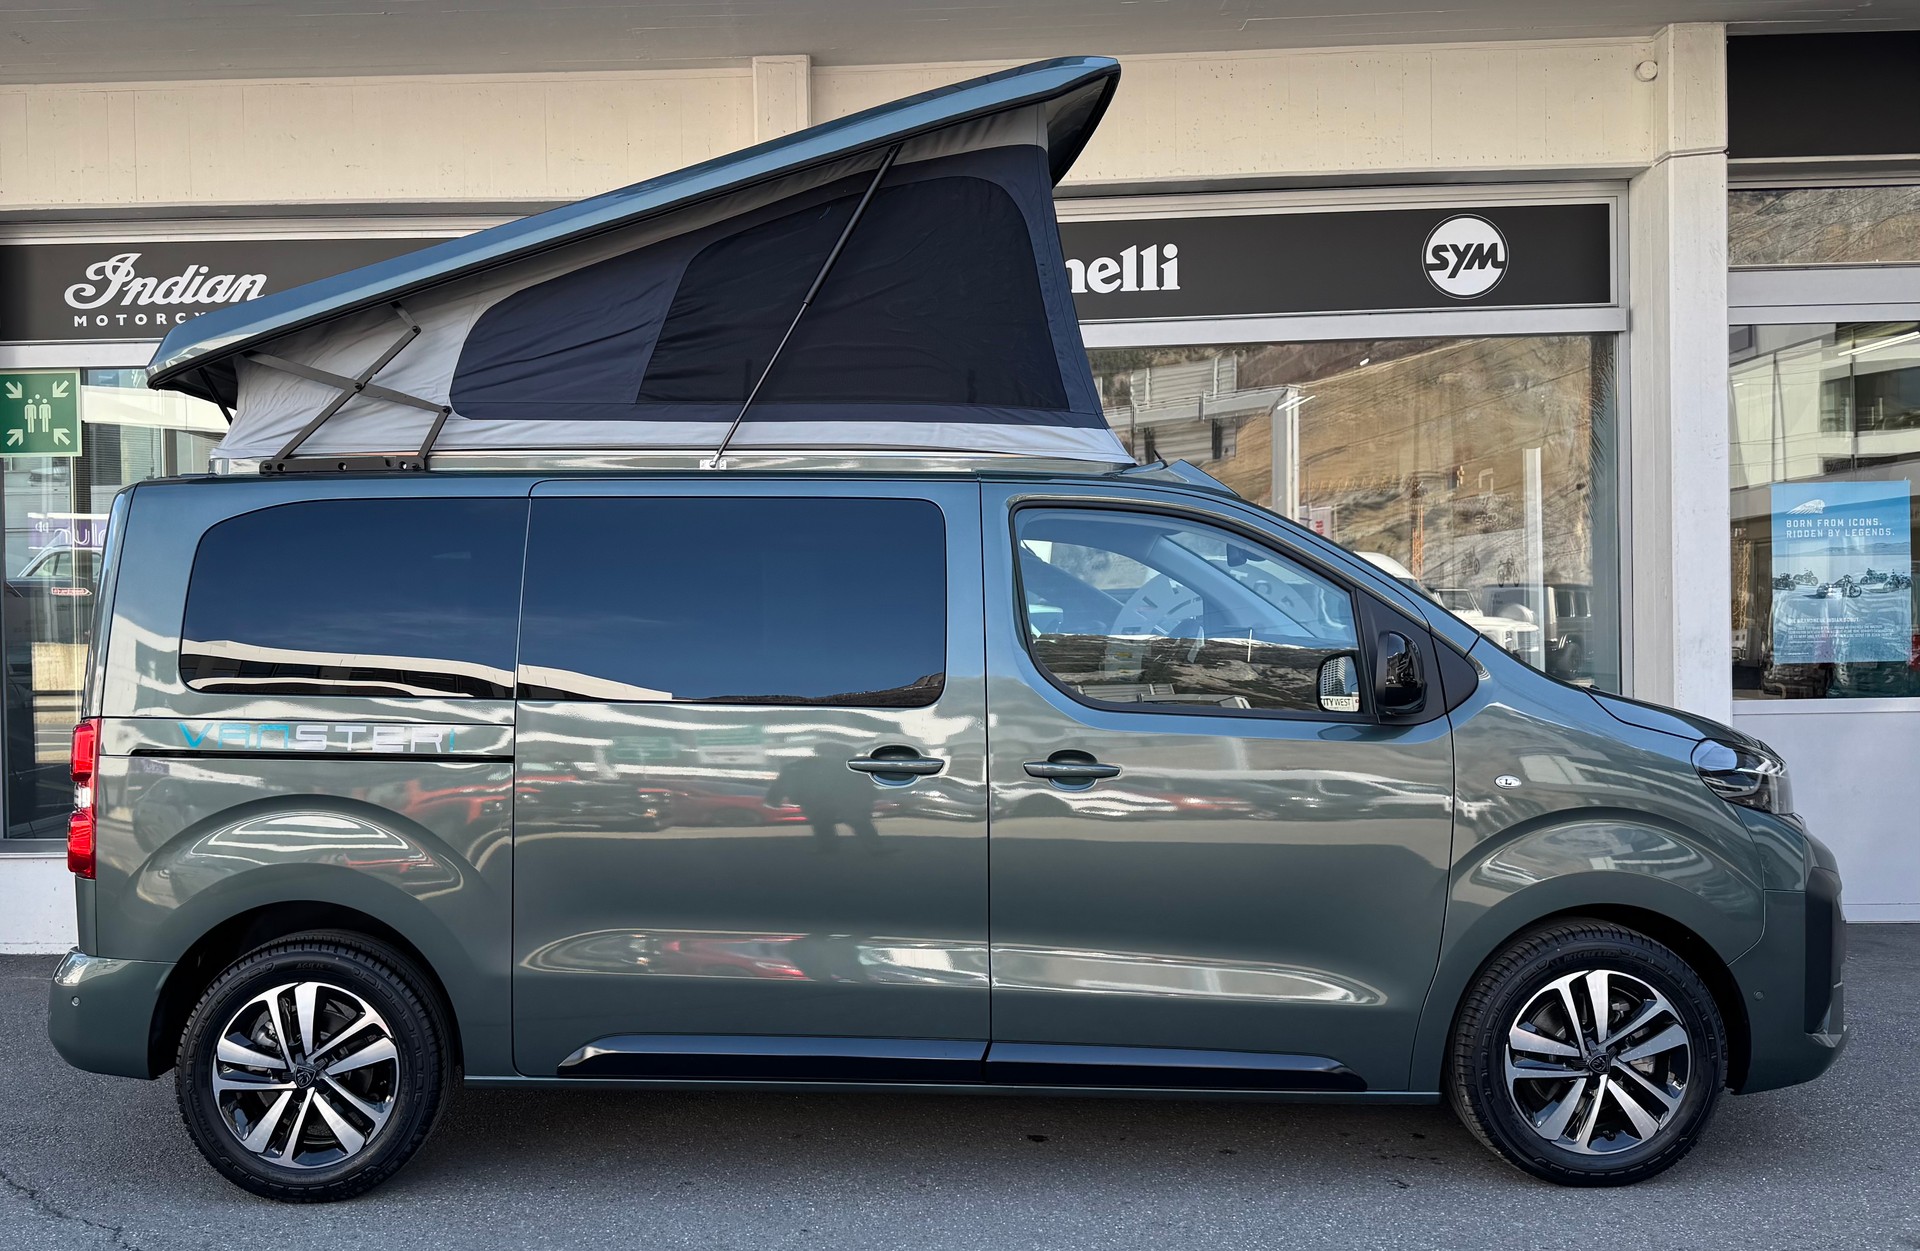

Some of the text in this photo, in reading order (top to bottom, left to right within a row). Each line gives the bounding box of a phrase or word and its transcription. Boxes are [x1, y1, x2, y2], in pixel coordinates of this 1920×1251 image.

[1426, 242, 1505, 279] SYM
[64, 252, 268, 310] Indian
[73, 312, 207, 328] MOTORC
[1786, 517, 1883, 528] BORN FROM ICONS.
[1786, 527, 1896, 539] RIDDEN BY LEGENDS.
[1321, 697, 1334, 707] ITY
